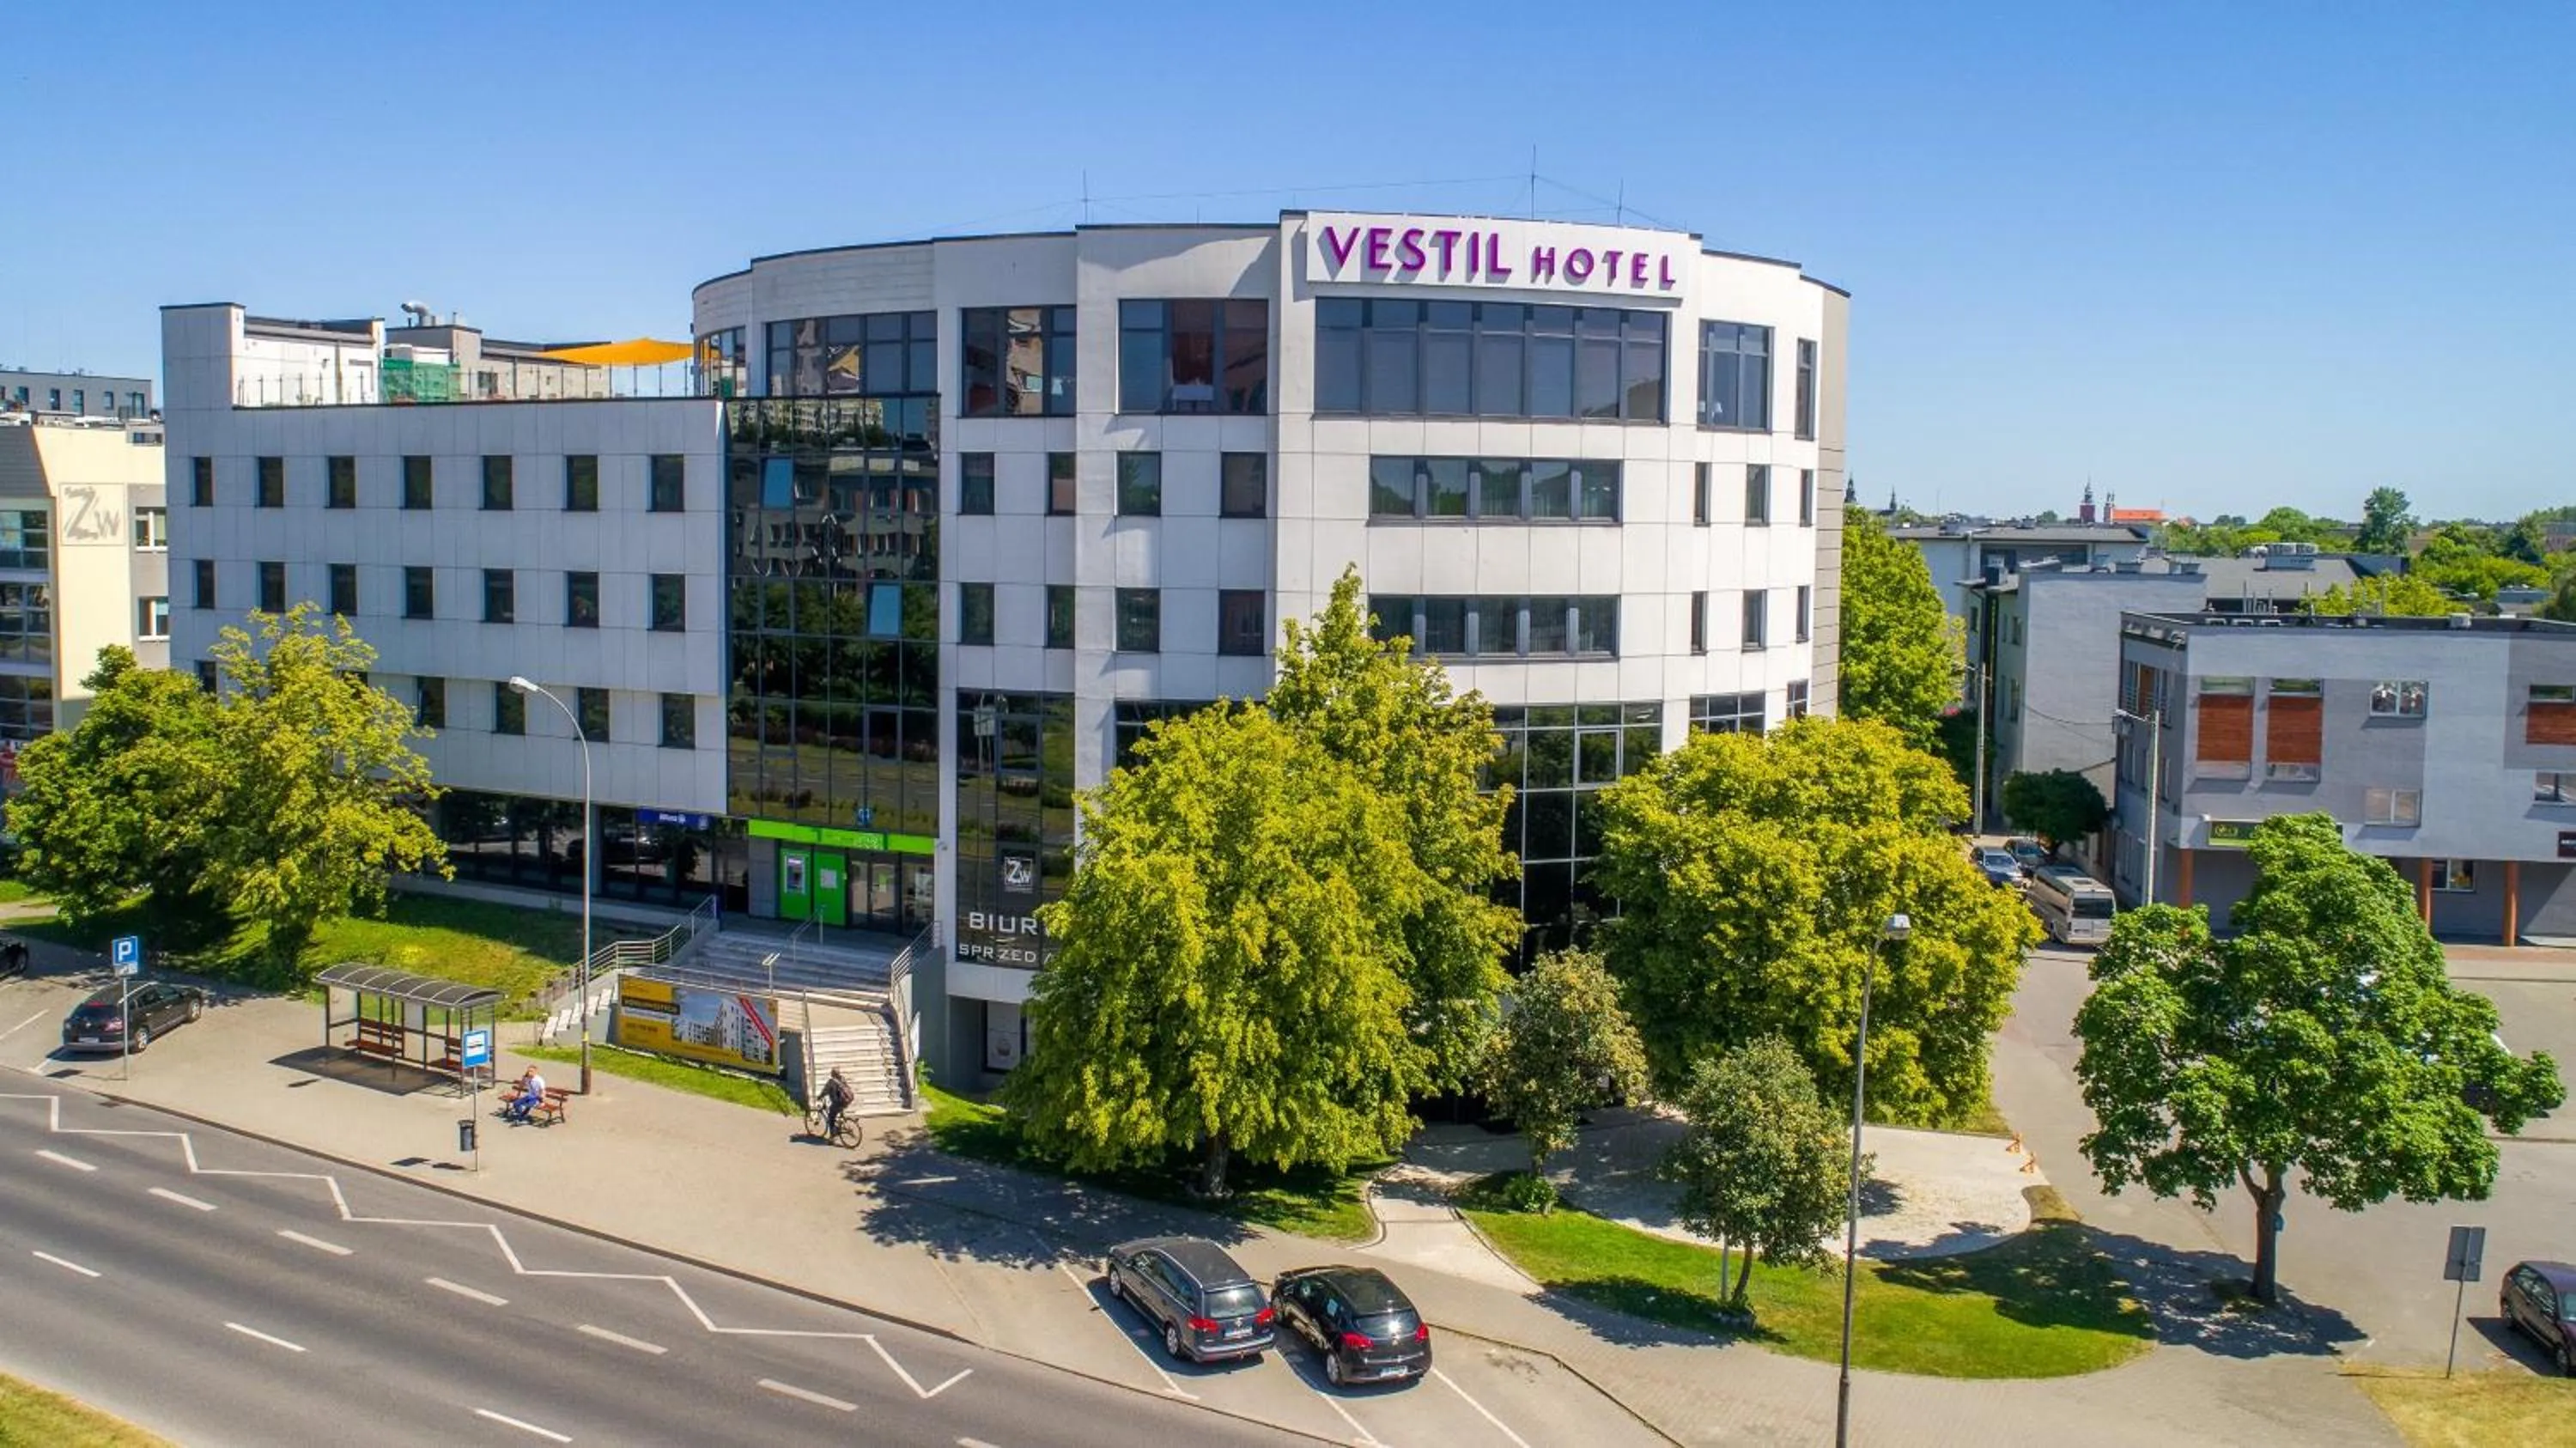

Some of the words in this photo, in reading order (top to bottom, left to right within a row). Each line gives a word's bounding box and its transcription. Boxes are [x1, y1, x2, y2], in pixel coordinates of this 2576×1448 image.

[1324, 226, 1512, 275] VESTIL
[1534, 246, 1677, 286] HOTEL
[969, 910, 1038, 936] BIUR
[118, 940, 132, 963] P
